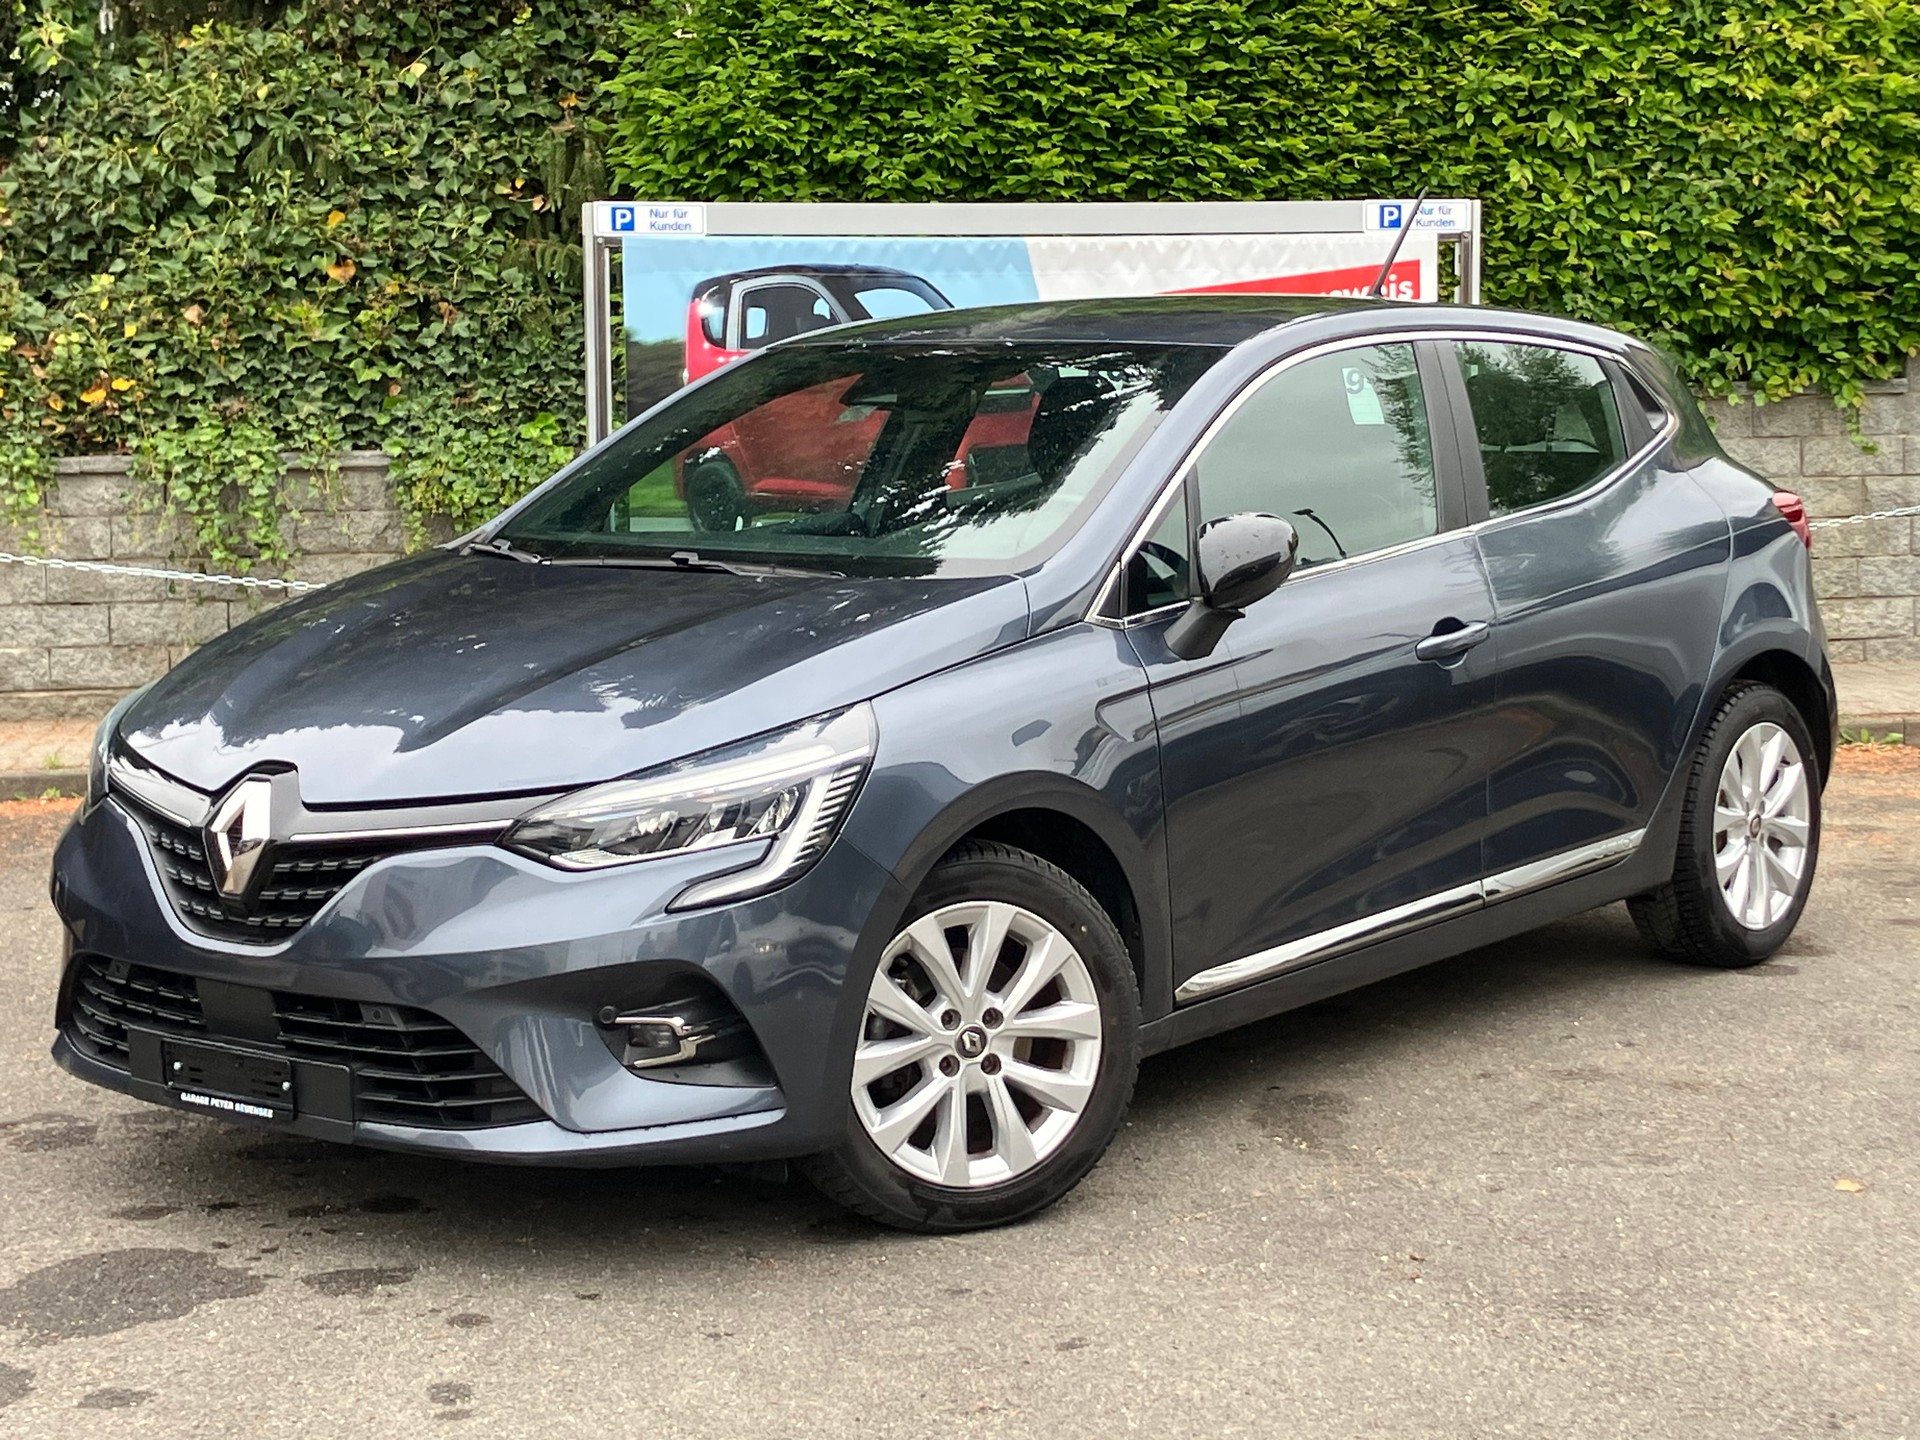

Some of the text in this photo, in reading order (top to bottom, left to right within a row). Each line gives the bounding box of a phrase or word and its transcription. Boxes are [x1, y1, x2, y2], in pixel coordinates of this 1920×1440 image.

[649, 207, 689, 219] Nur für
[1416, 204, 1453, 216] Nur für
[649, 220, 692, 231] Kunden
[1415, 217, 1456, 228] Kunden
[180, 1092, 209, 1105] GARAGE
[210, 1097, 234, 1110] PETER
